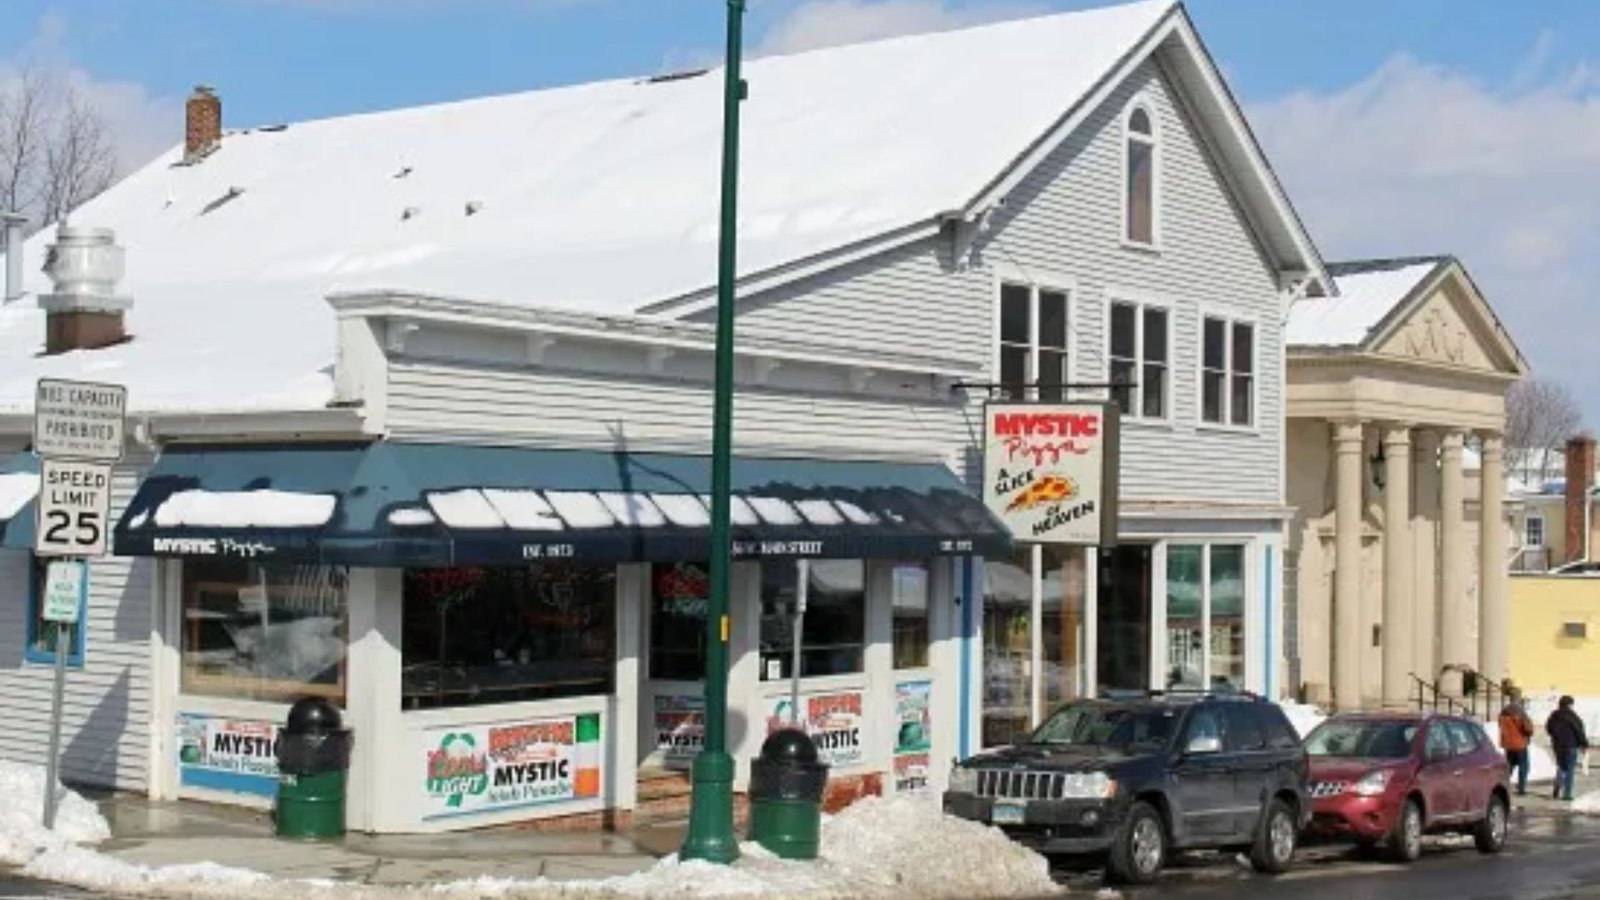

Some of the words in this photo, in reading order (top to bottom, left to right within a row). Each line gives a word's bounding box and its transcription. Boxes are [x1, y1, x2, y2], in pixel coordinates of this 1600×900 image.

[994, 413, 1098, 437] MYSTIC
[1003, 436, 1089, 467] Pizza
[47, 470, 105, 488] SPEED
[995, 469, 1035, 496] SLICE
[52, 489, 97, 507] LIMIT
[43, 509, 100, 545] 25
[1032, 500, 1094, 537] HEAVEN
[153, 537, 217, 554] MYSTIC
[494, 758, 569, 787] MYSTIC
